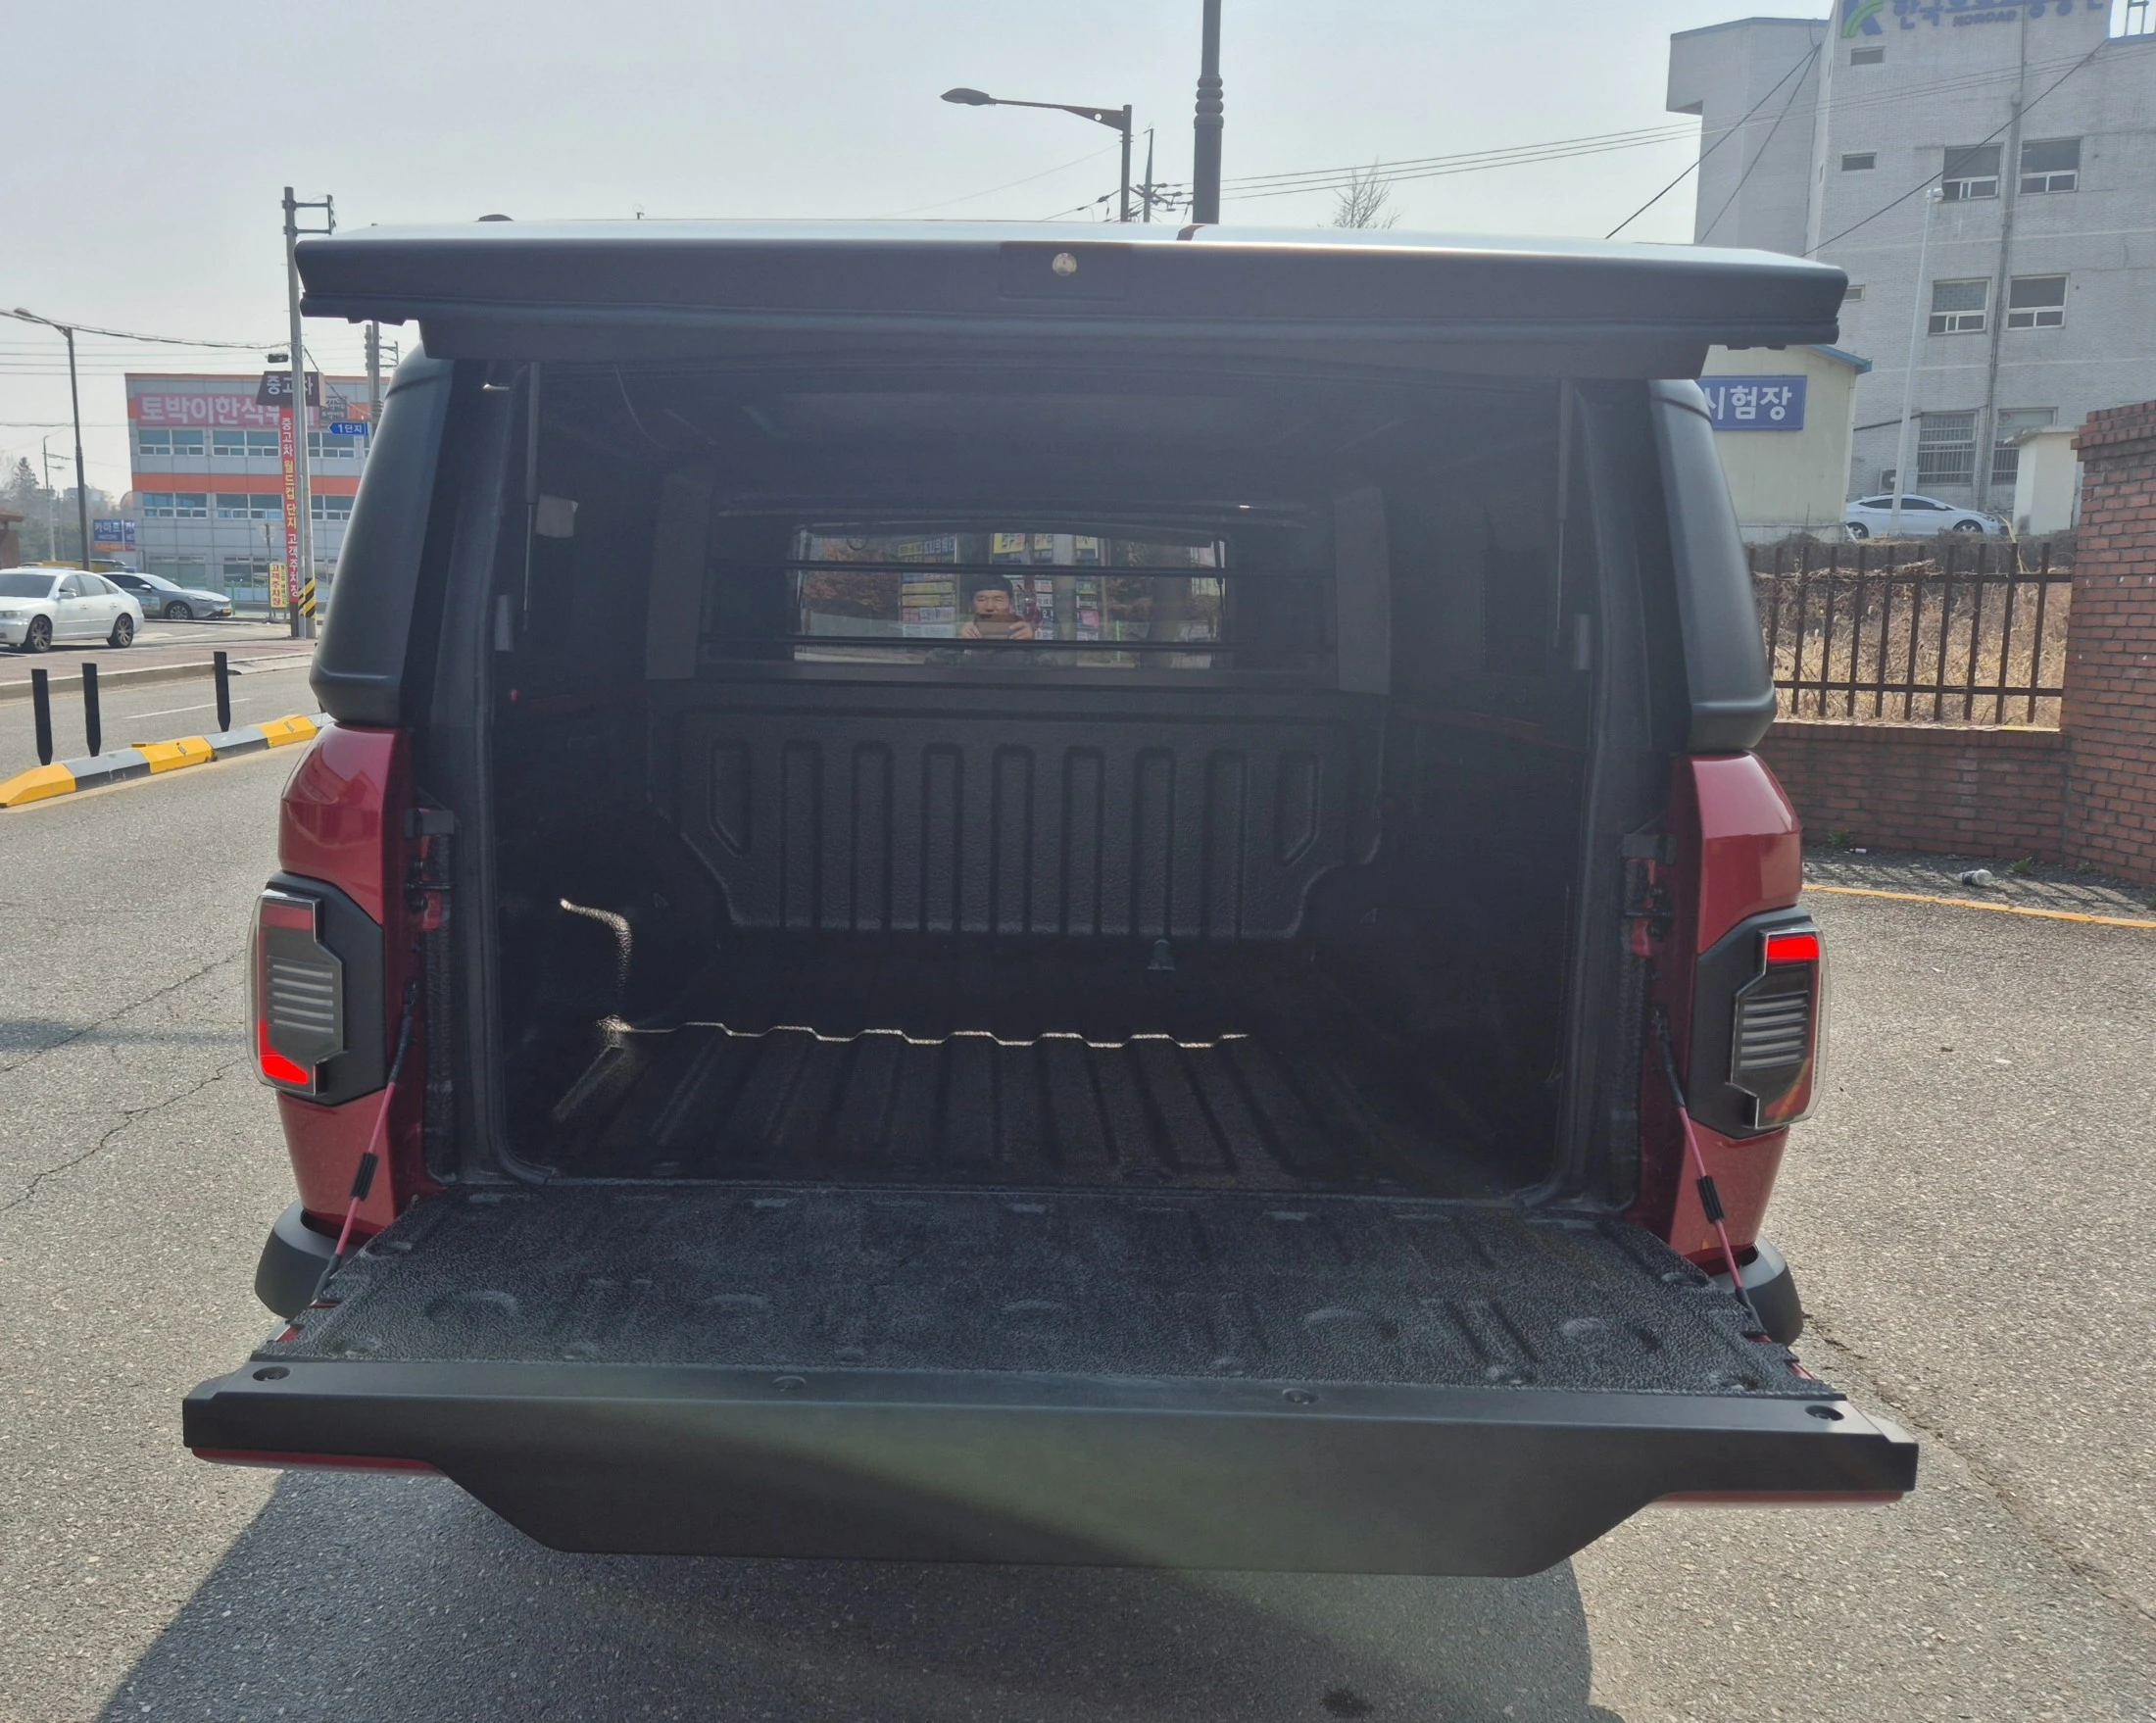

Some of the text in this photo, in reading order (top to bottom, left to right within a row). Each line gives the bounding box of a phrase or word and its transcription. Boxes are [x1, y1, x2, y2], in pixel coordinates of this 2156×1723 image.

[1953, 10, 2018, 27] KOROAD
[267, 374, 314, 396] 중고차
[1704, 385, 1792, 420] 시험장
[281, 417, 293, 458] 중고차
[337, 423, 363, 434] 1단지
[283, 460, 296, 501] 월드컵
[286, 503, 298, 529] 단지
